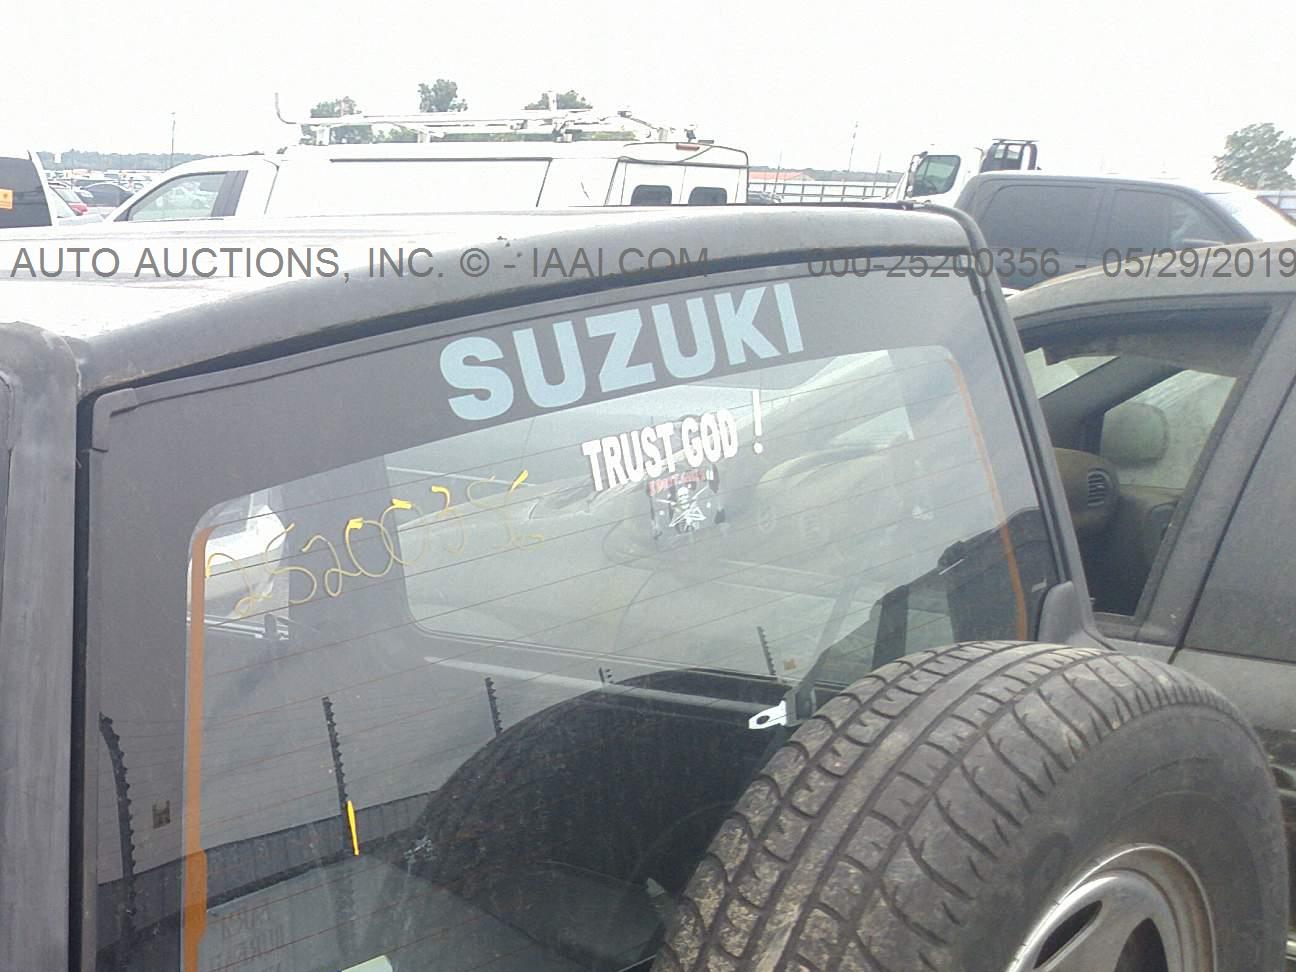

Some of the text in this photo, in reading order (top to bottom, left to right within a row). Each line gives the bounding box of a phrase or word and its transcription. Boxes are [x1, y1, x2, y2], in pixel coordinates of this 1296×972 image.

[439, 283, 804, 421] SUZUKI
[582, 422, 676, 491] TRUST
[681, 408, 738, 468] GOD
